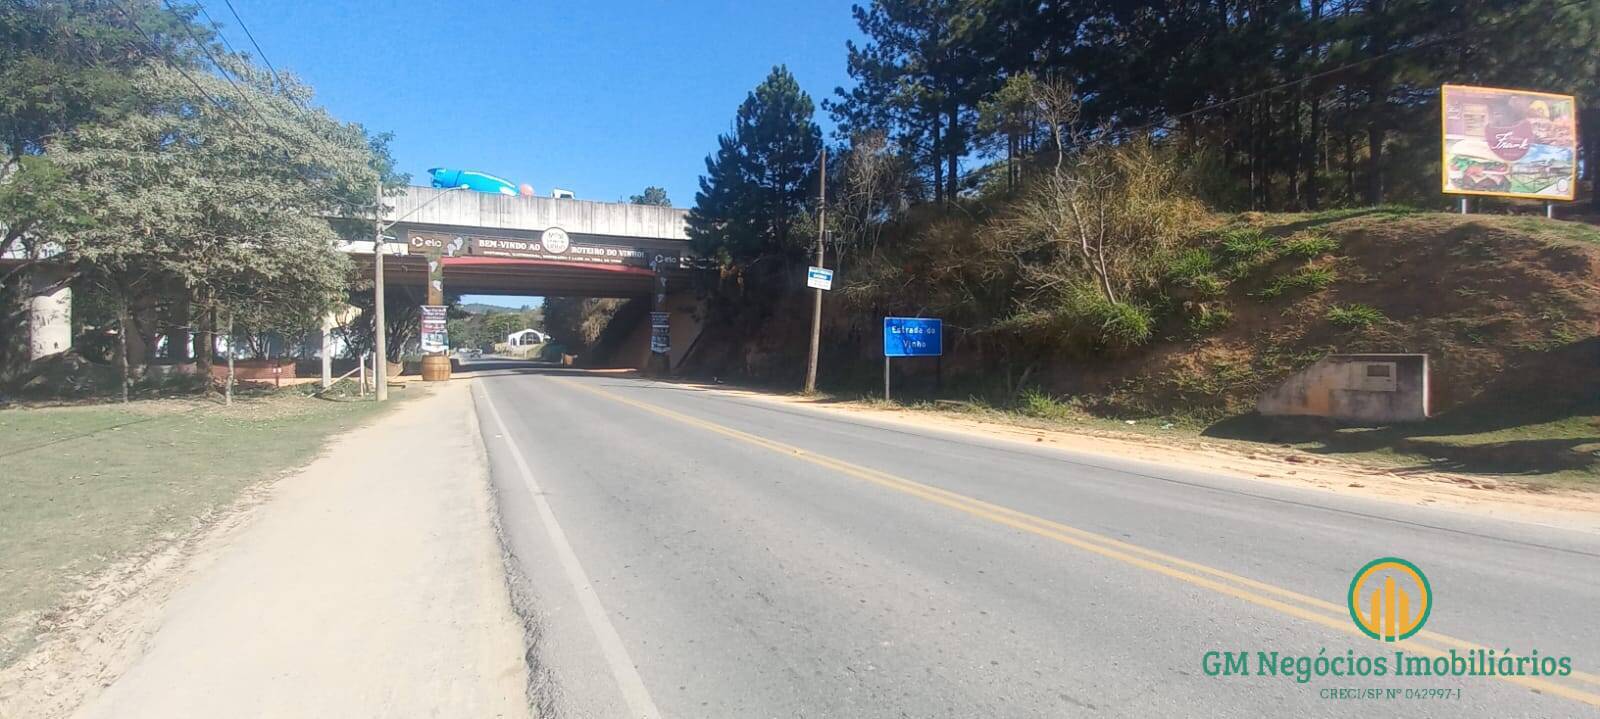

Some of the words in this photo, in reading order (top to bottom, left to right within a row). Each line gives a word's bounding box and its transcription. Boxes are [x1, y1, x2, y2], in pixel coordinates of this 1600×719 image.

[479, 240, 527, 250] BEM-VINDO
[528, 242, 540, 251] AO
[571, 247, 604, 256] ROTEIRO
[892, 325, 923, 333] Estrada
[903, 340, 926, 348] Vinho
